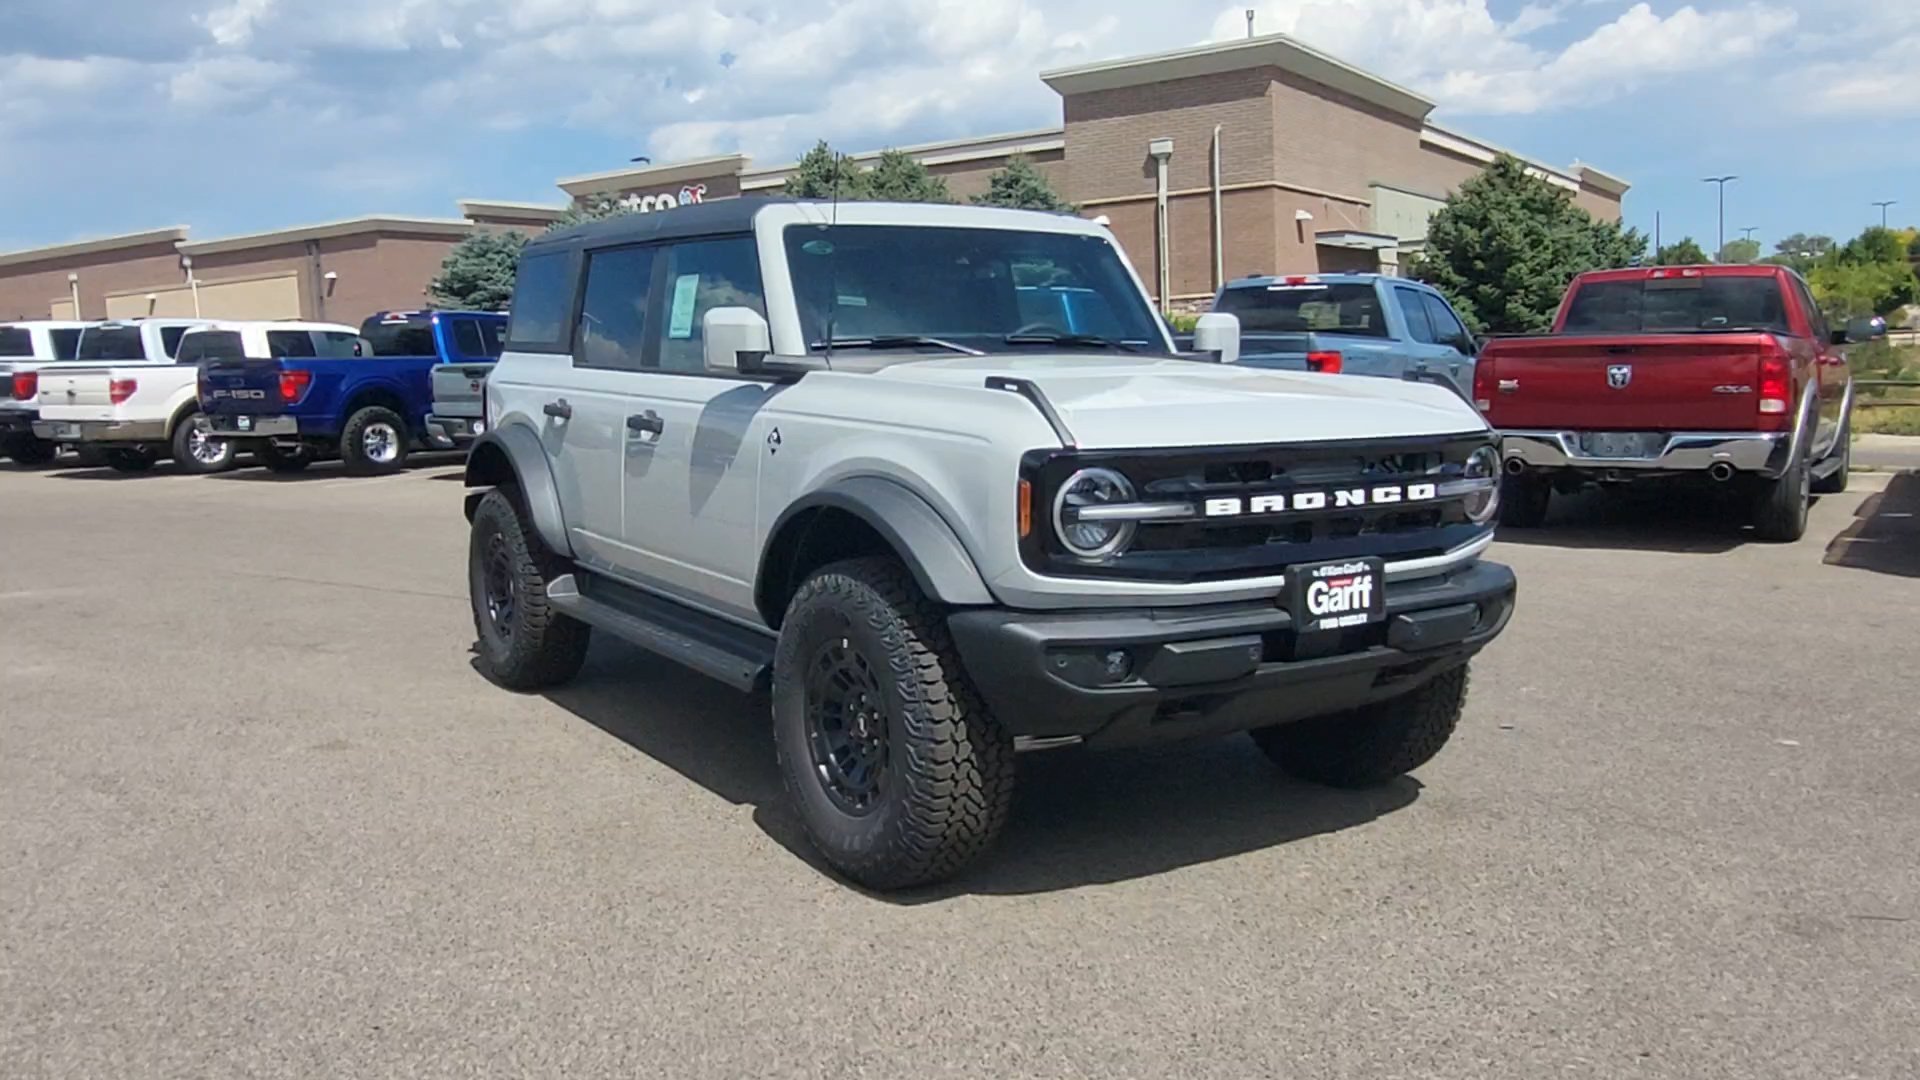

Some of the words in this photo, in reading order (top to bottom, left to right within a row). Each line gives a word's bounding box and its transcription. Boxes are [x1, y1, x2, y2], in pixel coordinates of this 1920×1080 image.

[213, 389, 264, 399] F-150
[1205, 483, 1435, 516] BRONCO
[1307, 574, 1372, 615] Garff
